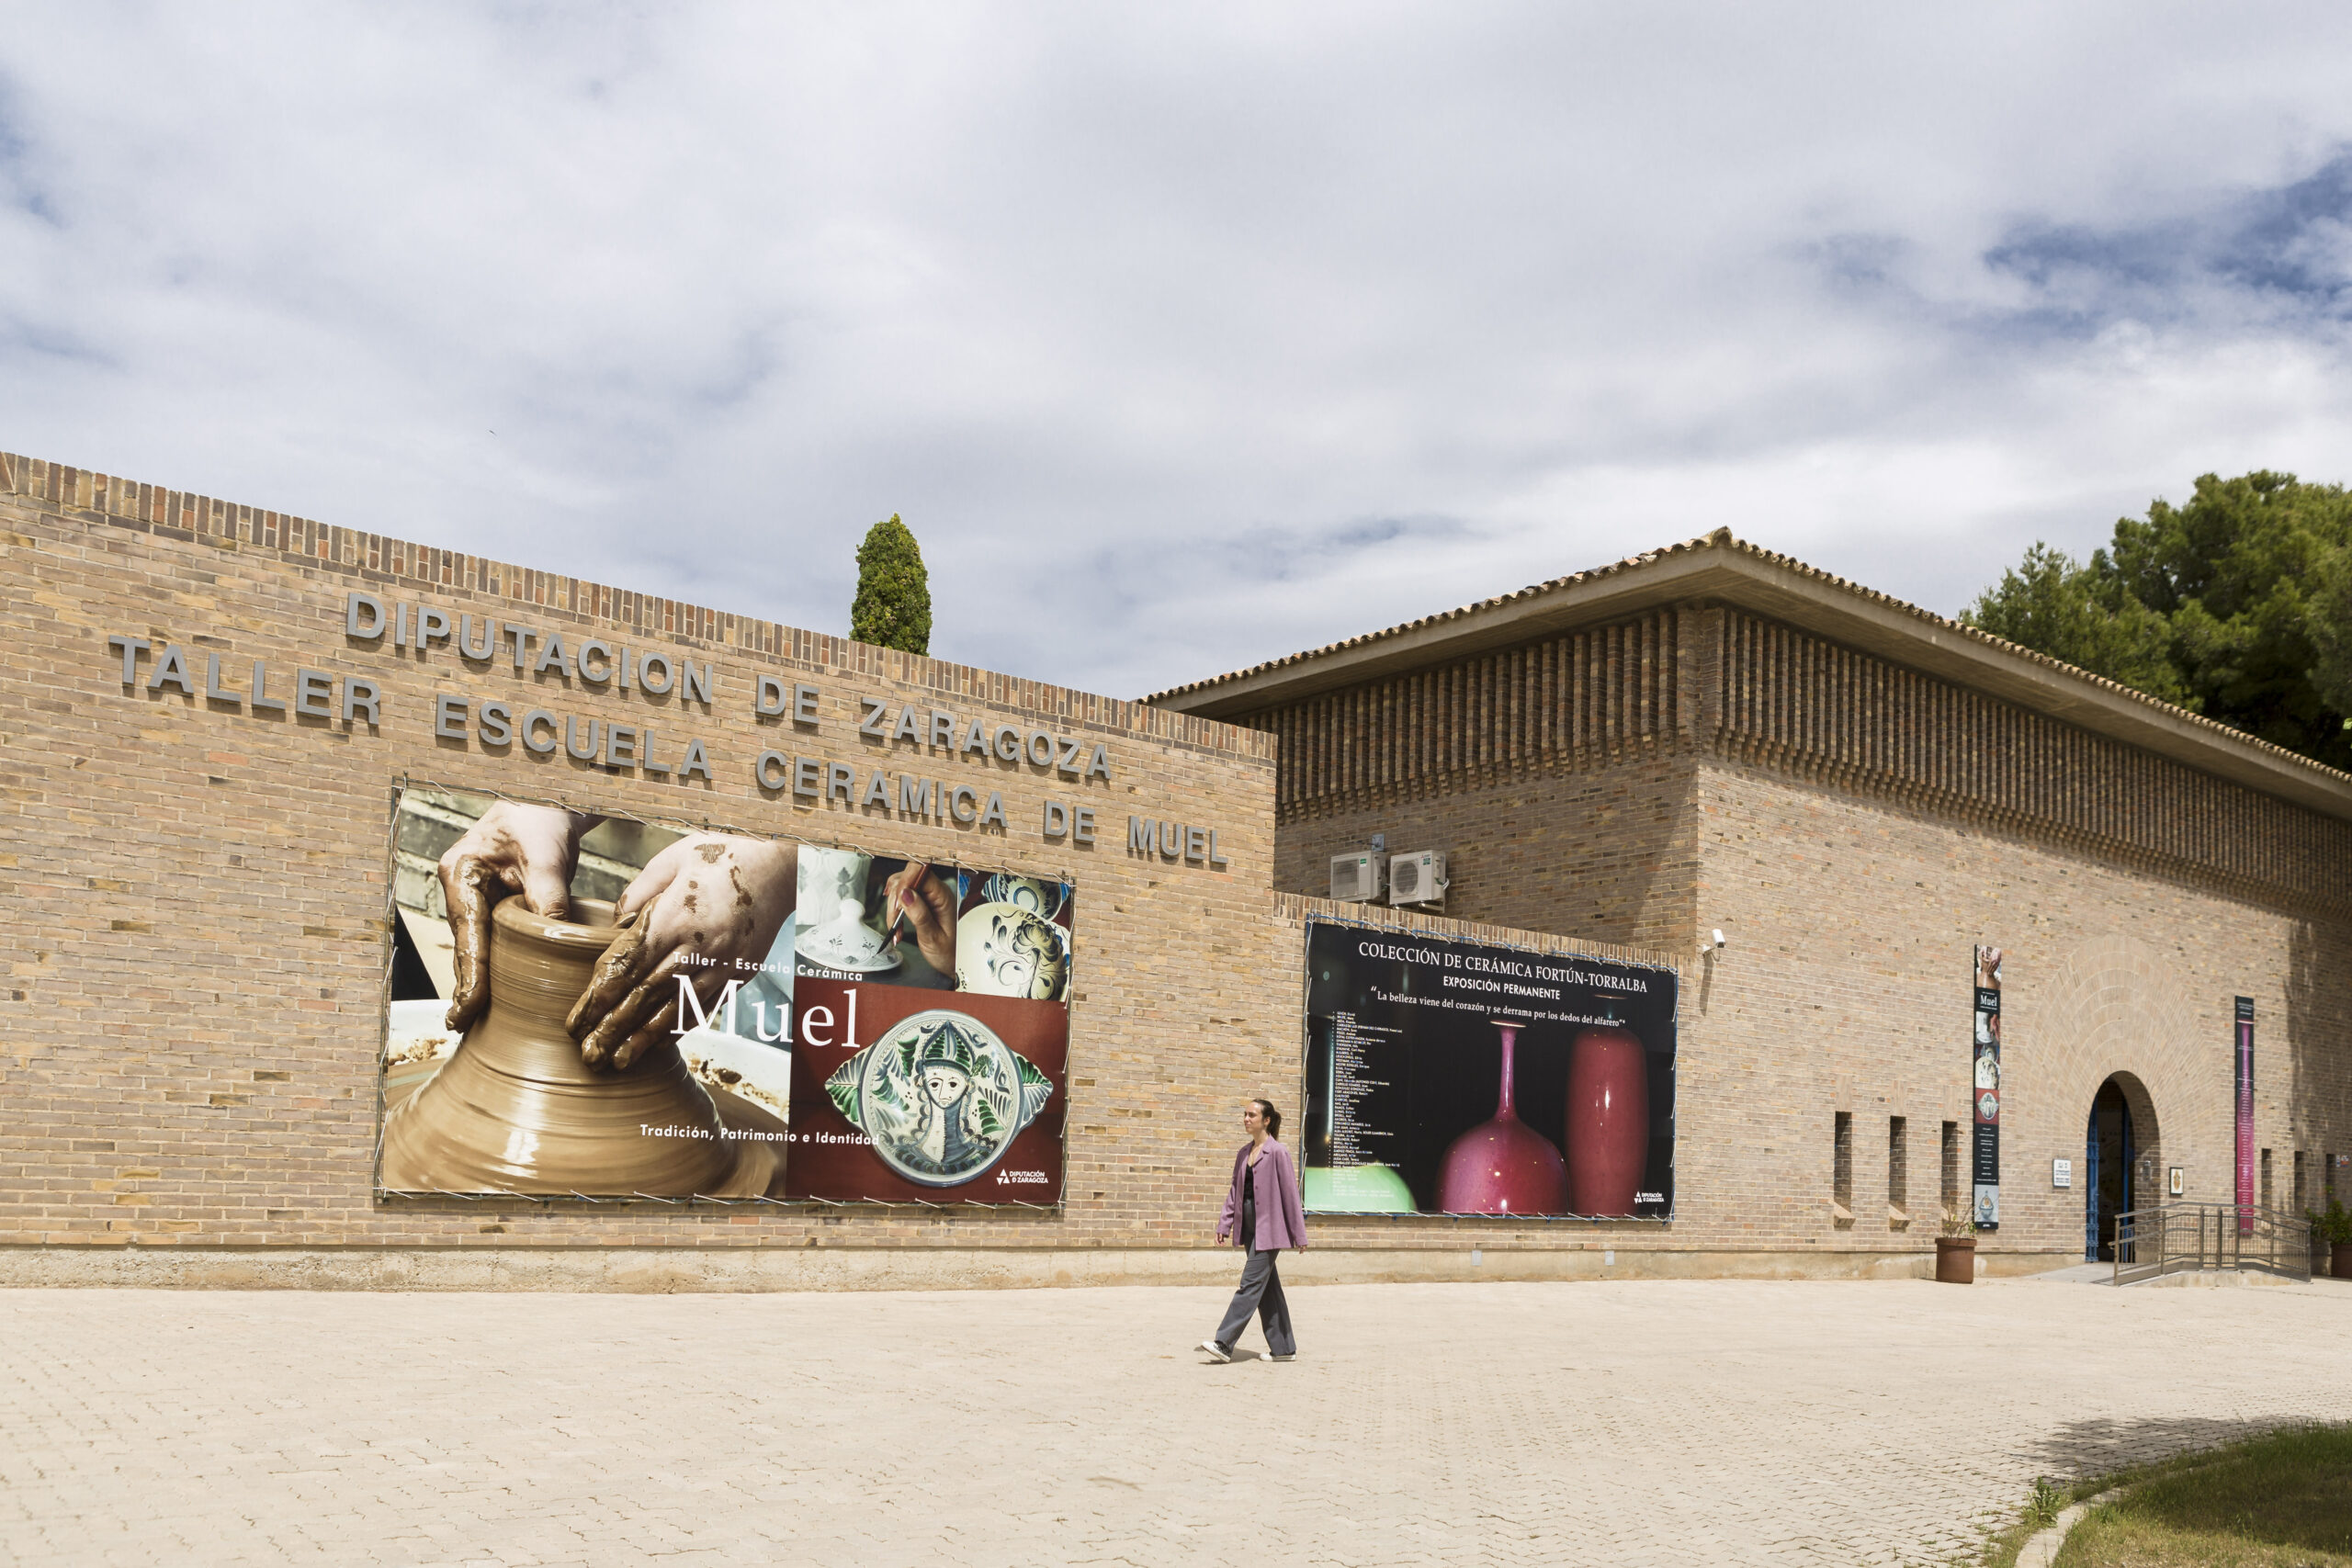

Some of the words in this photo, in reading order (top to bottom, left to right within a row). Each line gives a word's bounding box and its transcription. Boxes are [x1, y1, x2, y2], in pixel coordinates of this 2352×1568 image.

[345, 592, 713, 705] DIPUTACION
[756, 674, 820, 725] DE
[859, 696, 1111, 780] ZARAGOZA
[108, 635, 381, 726] TALLER
[435, 694, 712, 780] ESCUELA
[756, 750, 1008, 829] CERAMICA
[1044, 800, 1096, 843] DE
[1127, 815, 1228, 864] MUEL
[673, 951, 717, 966] Taller
[736, 958, 790, 975] Escuela
[797, 964, 863, 981] Cerámica
[1359, 942, 1441, 966] COLECCIÓN
[1444, 953, 1462, 968] DE
[1465, 956, 1532, 978] CERÁMICA
[1535, 966, 1647, 993] FORTÚN-TORRALBA
[1443, 976, 1500, 993] EXPOSICIÓN
[1503, 983, 1561, 1000] PERMANENTE
[1980, 995, 1997, 1007] Muel
[670, 974, 861, 1048] Muel
[1389, 992, 1417, 1004] belleza
[1419, 997, 1440, 1007] viene
[1442, 998, 1453, 1009] del
[1455, 1002, 1485, 1011] corazón
[1486, 1005, 1491, 1015] y
[1502, 1005, 1532, 1017] derrama
[1533, 1011, 1545, 1021] por
[1547, 1010, 1558, 1021] los
[1560, 1011, 1580, 1023] dedos
[1581, 1015, 1592, 1024] del
[640, 1124, 714, 1141] Tradición,
[720, 1128, 797, 1143] Patrimonio
[803, 1134, 809, 1143] e
[816, 1133, 879, 1145] Identidad
[1009, 1169, 1046, 1178] DIPUTACIÓN
